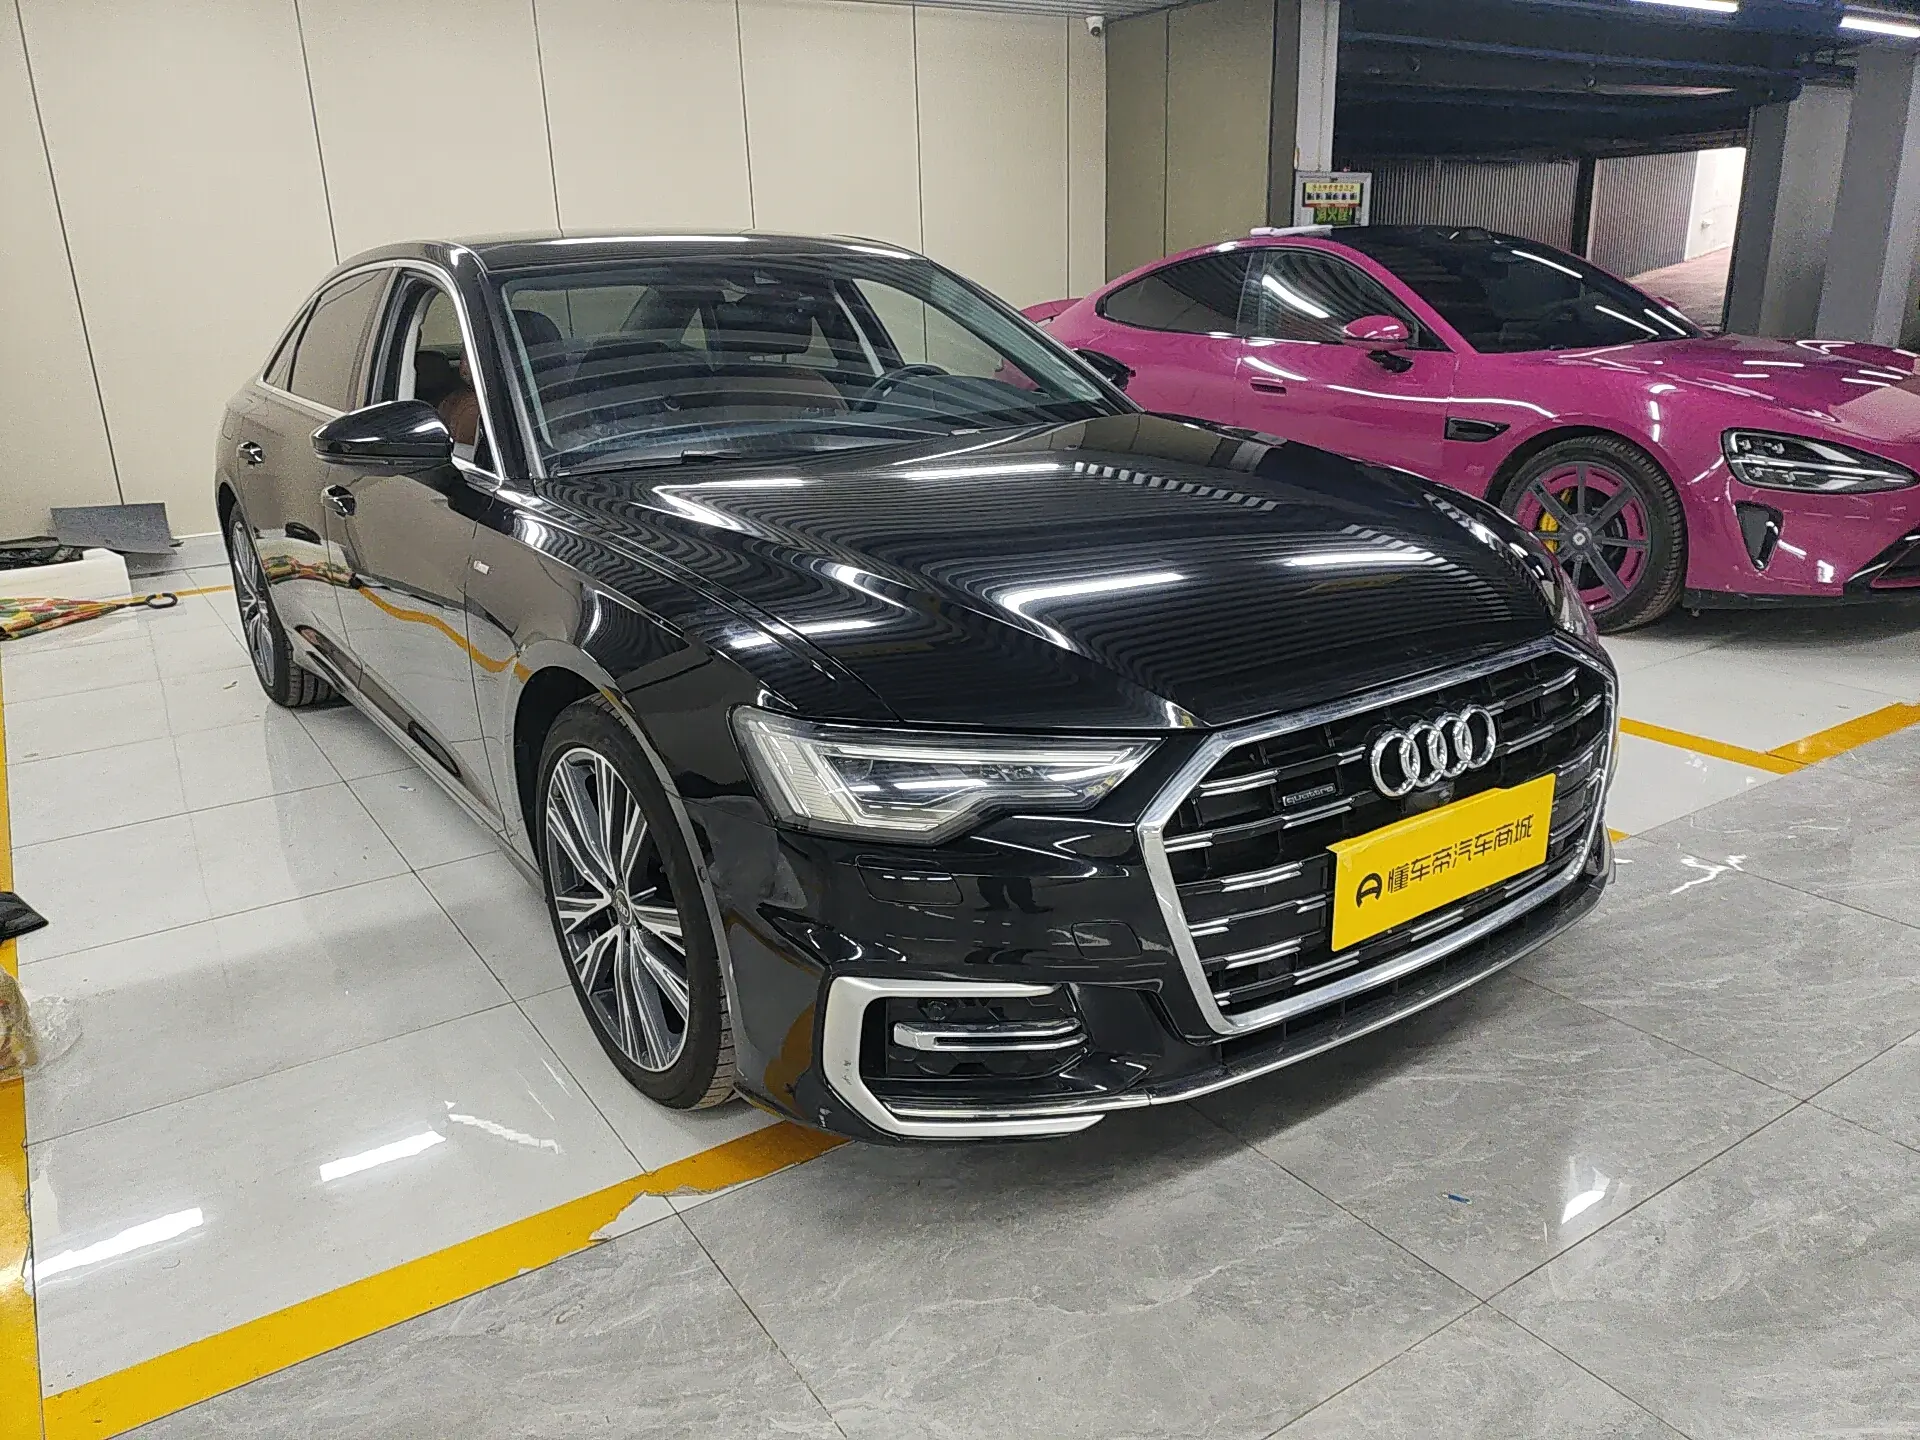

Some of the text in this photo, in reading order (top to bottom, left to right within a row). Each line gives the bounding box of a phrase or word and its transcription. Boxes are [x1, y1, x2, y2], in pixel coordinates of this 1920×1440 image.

[1286, 785, 1334, 804] quattro
[1387, 814, 1534, 893] 懂车帝汽车商城
